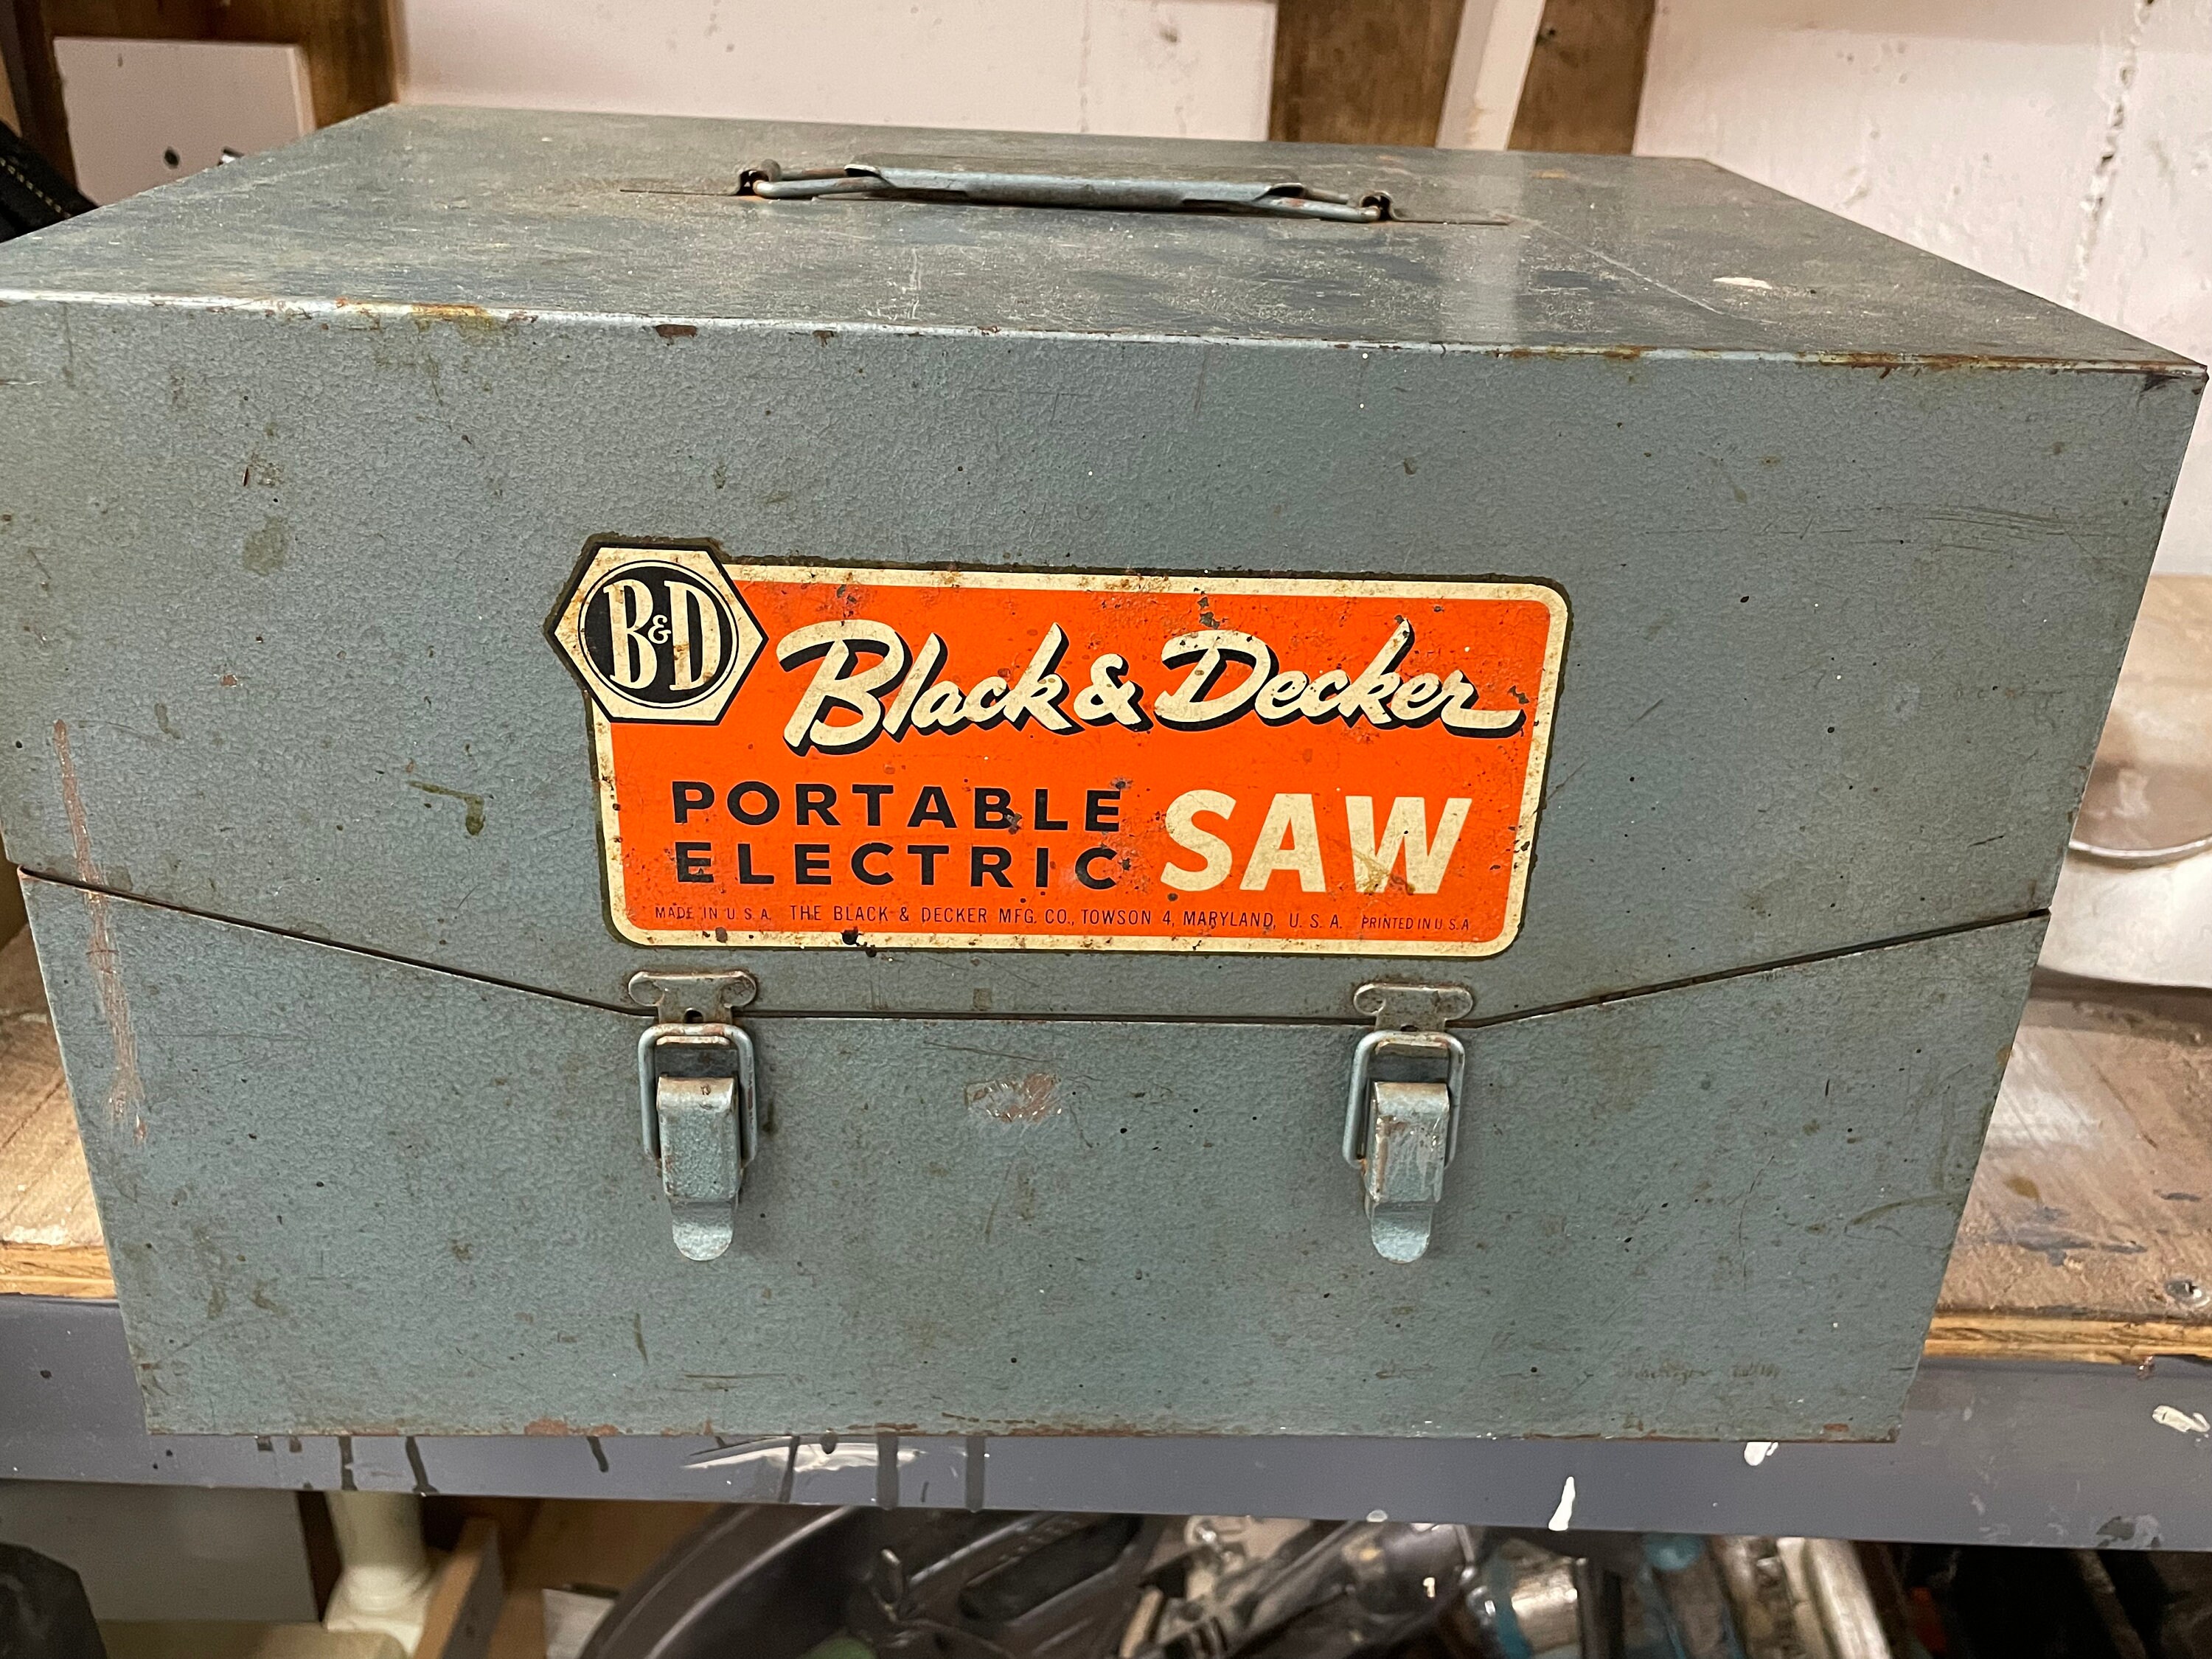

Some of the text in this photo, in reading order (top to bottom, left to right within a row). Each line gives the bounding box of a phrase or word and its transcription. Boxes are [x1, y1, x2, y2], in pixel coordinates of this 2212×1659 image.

[602, 579, 722, 692] B&D
[776, 617, 1527, 757] Black & Decker
[672, 780, 1121, 832] PORTABLE
[675, 841, 1119, 890] ELECTRIC
[1160, 788, 1472, 894] SAW
[655, 906, 693, 920] MADE
[703, 906, 717, 919] IN
[790, 905, 821, 921] THE
[833, 905, 888, 922] BLACK
[899, 906, 909, 922] &
[921, 907, 987, 923] DECKER
[999, 908, 1037, 924] MFG.
[1045, 908, 1074, 926] CO.,
[1082, 908, 1151, 925] TOWSON
[1162, 910, 1175, 928] 4,
[1183, 911, 1276, 930] MARYLAND,
[1361, 915, 1413, 930] PRINTED
[1417, 917, 1431, 930] IN
